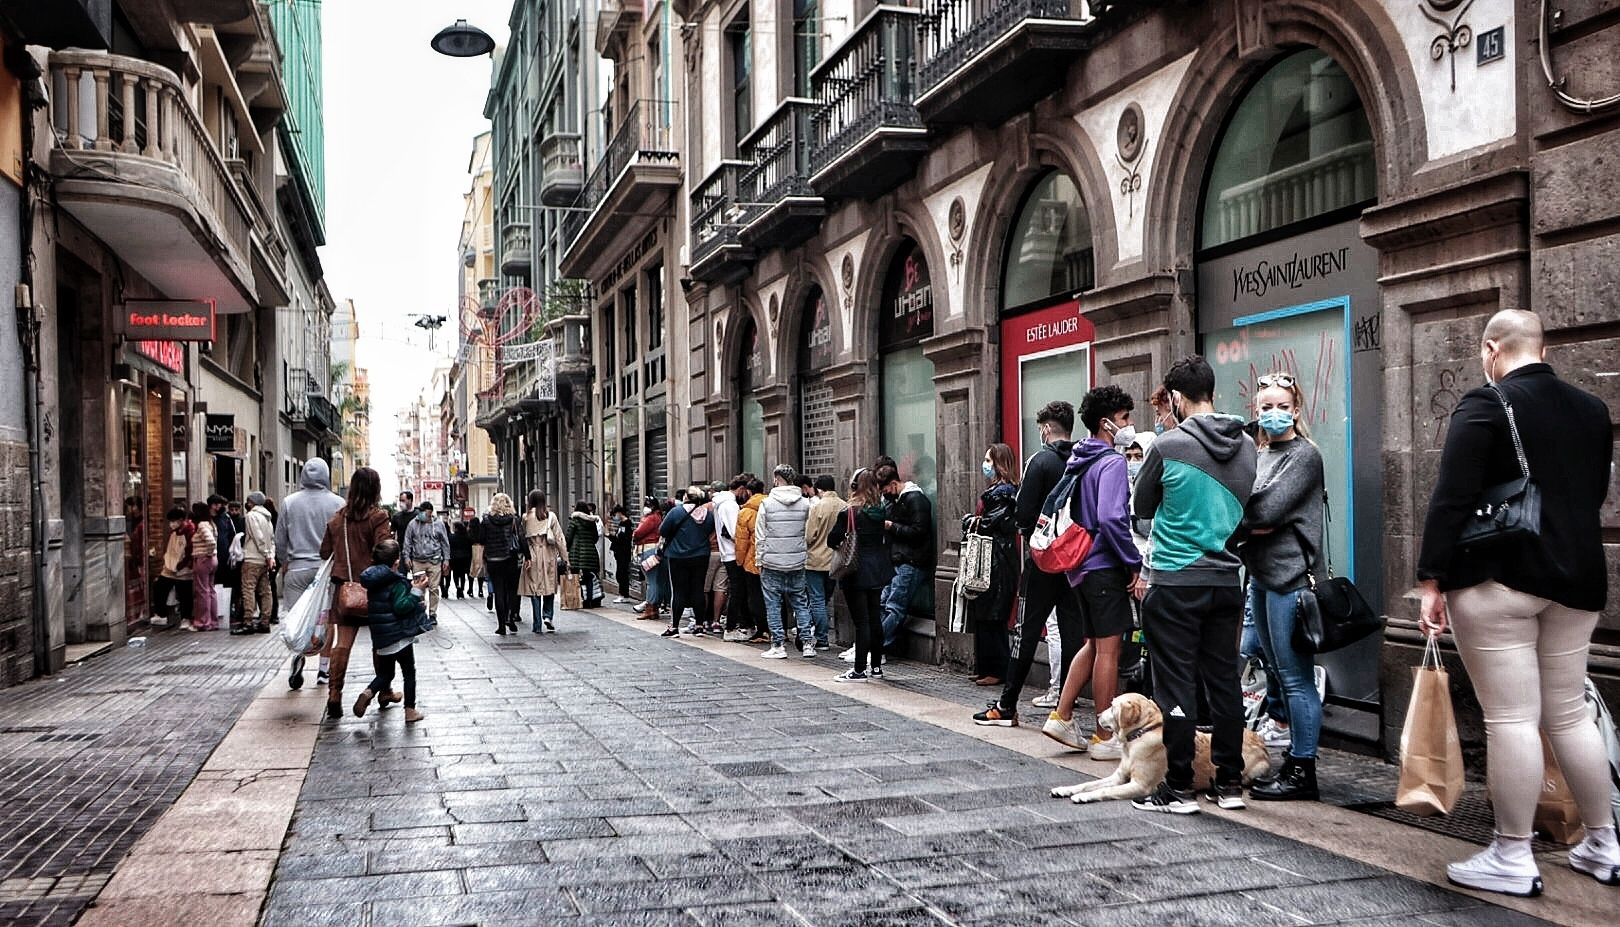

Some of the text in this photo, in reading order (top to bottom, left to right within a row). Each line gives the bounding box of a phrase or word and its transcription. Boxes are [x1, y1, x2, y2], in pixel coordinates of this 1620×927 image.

[1482, 31, 1499, 59] 45
[894, 284, 932, 319] urban
[1026, 316, 1078, 343] ESTÉE LAUDER
[206, 424, 234, 437] NYX
